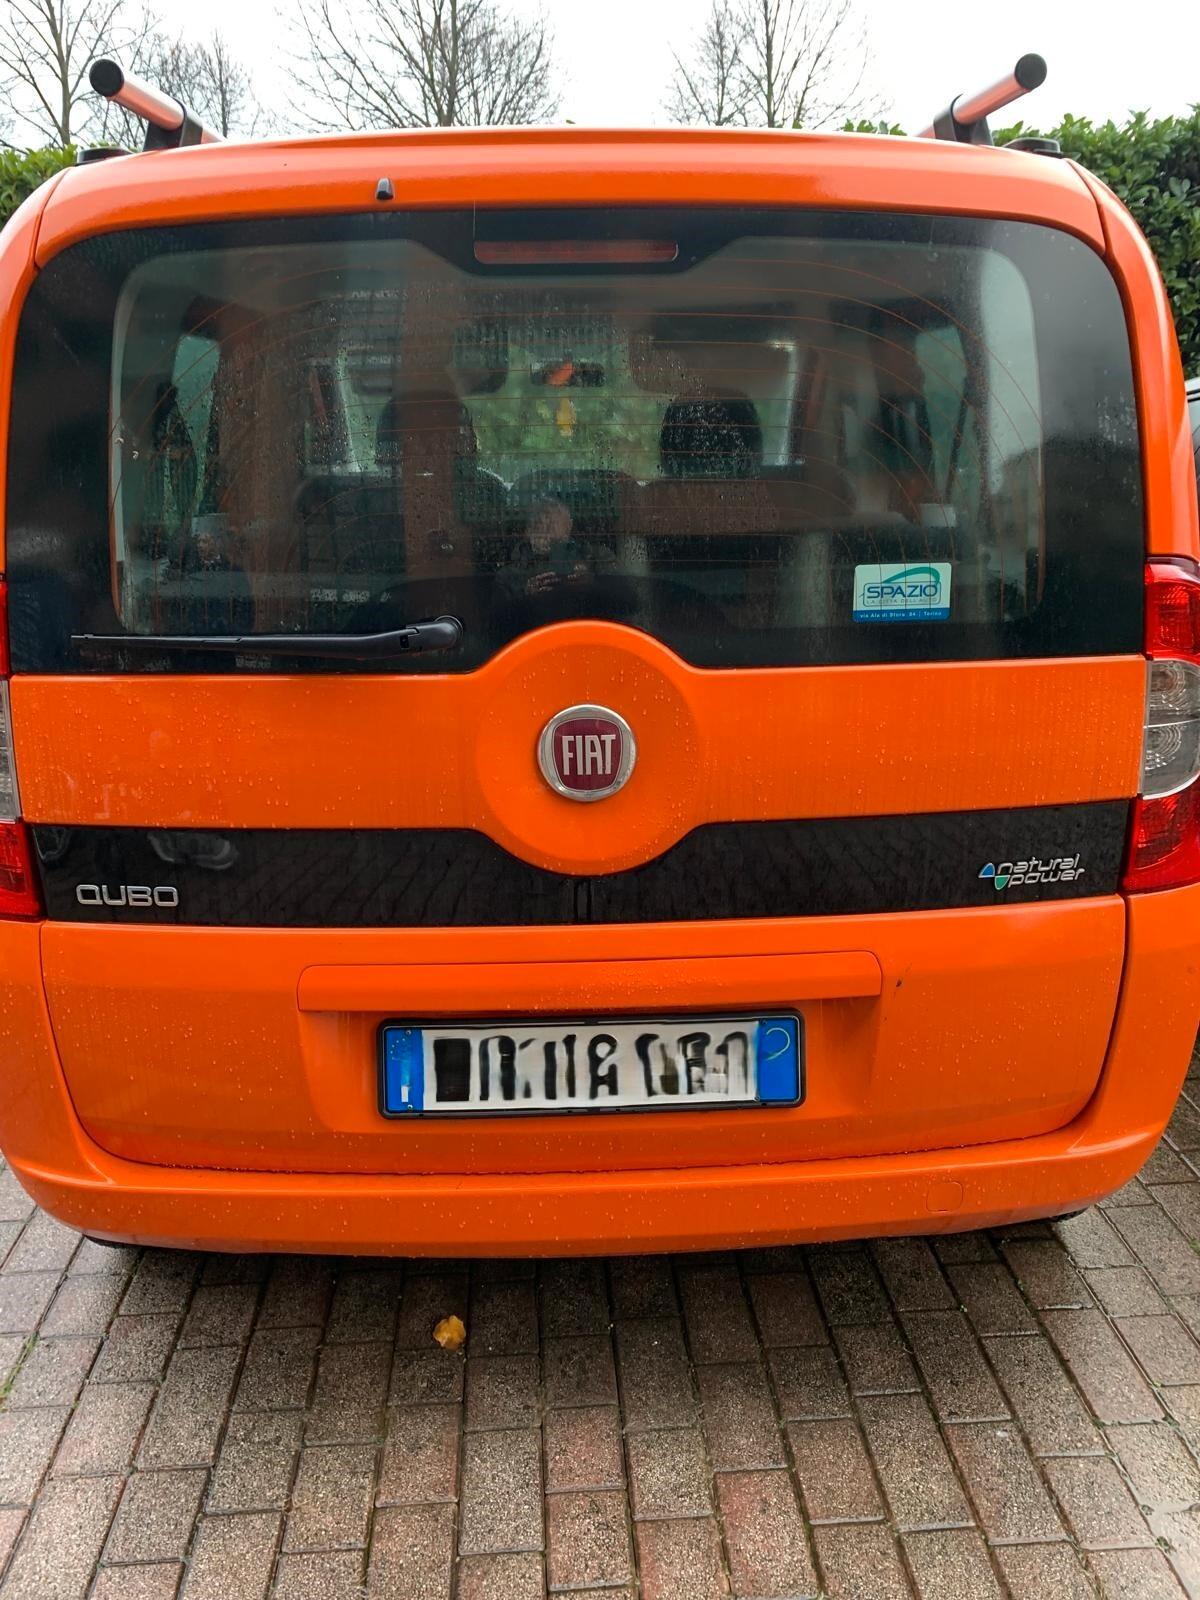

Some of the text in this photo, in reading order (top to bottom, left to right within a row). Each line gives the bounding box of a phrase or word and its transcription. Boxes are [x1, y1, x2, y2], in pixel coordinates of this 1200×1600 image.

[866, 585, 938, 599] SPAZIO
[562, 734, 616, 775] FIAT
[997, 853, 1080, 875] natural
[1007, 868, 1086, 888] power
[76, 884, 179, 907] QUBO
